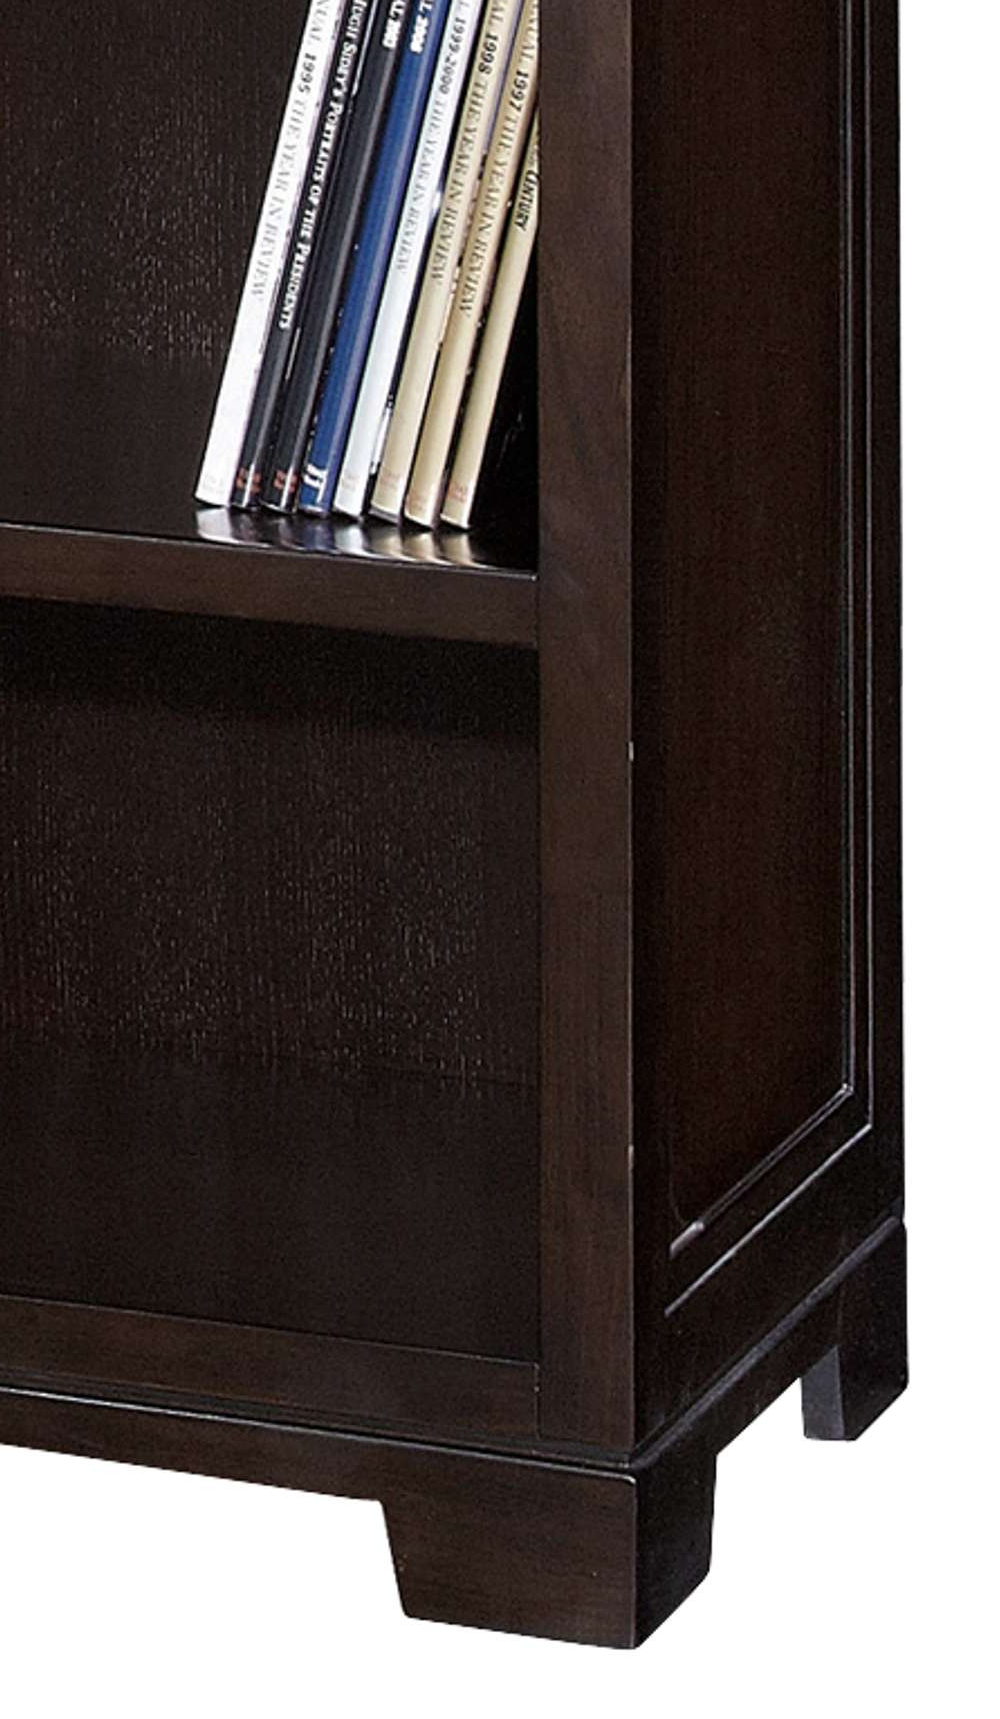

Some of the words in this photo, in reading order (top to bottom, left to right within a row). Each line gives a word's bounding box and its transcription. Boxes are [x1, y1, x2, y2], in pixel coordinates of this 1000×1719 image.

[297, 53, 316, 95] 1995
[439, 17, 466, 96] 1999-2000
[478, 32, 498, 75] 1998
[467, 81, 485, 121] THE
[507, 69, 528, 112] 1997
[287, 98, 306, 139] THE
[429, 100, 446, 136] THE
[496, 115, 516, 155] THE
[275, 142, 296, 192] YEAR
[419, 139, 436, 180] YEAR
[454, 125, 476, 175] YEAR
[413, 184, 425, 203] IN
[448, 180, 463, 202] IN
[483, 158, 506, 210] YEAR
[269, 196, 284, 218] IN
[477, 213, 492, 235] IN
[250, 222, 277, 297] REVIEW
[396, 207, 420, 275] REVIEW
[429, 207, 457, 285] REVIEW
[458, 238, 487, 317] REVIEW
